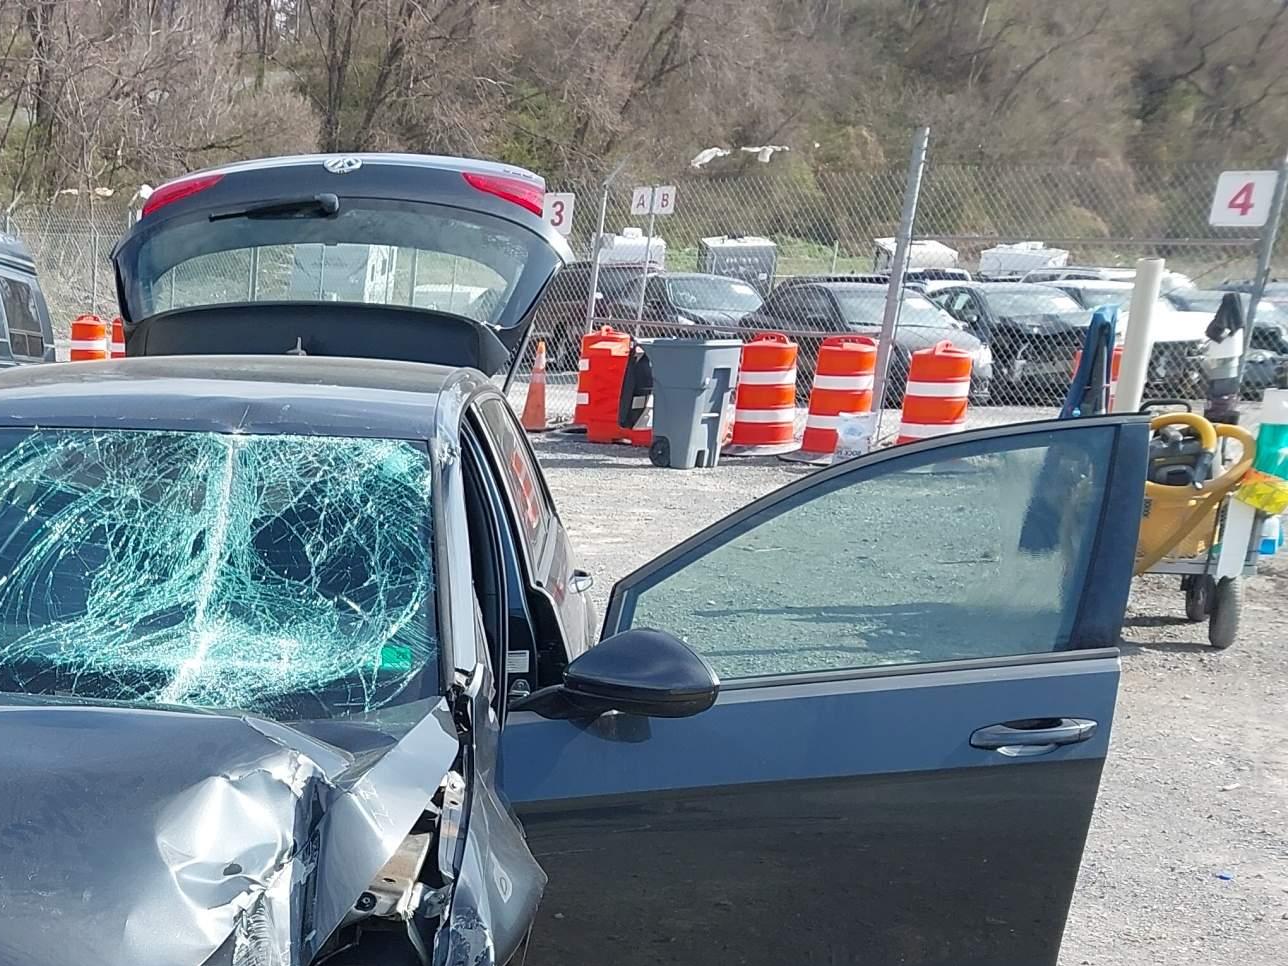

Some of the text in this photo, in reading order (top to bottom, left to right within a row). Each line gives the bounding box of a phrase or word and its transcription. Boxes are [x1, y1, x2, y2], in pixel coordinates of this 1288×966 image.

[636, 193, 646, 209] A
[661, 193, 670, 208] B
[1227, 182, 1255, 216] 4
[550, 200, 565, 227] 3
